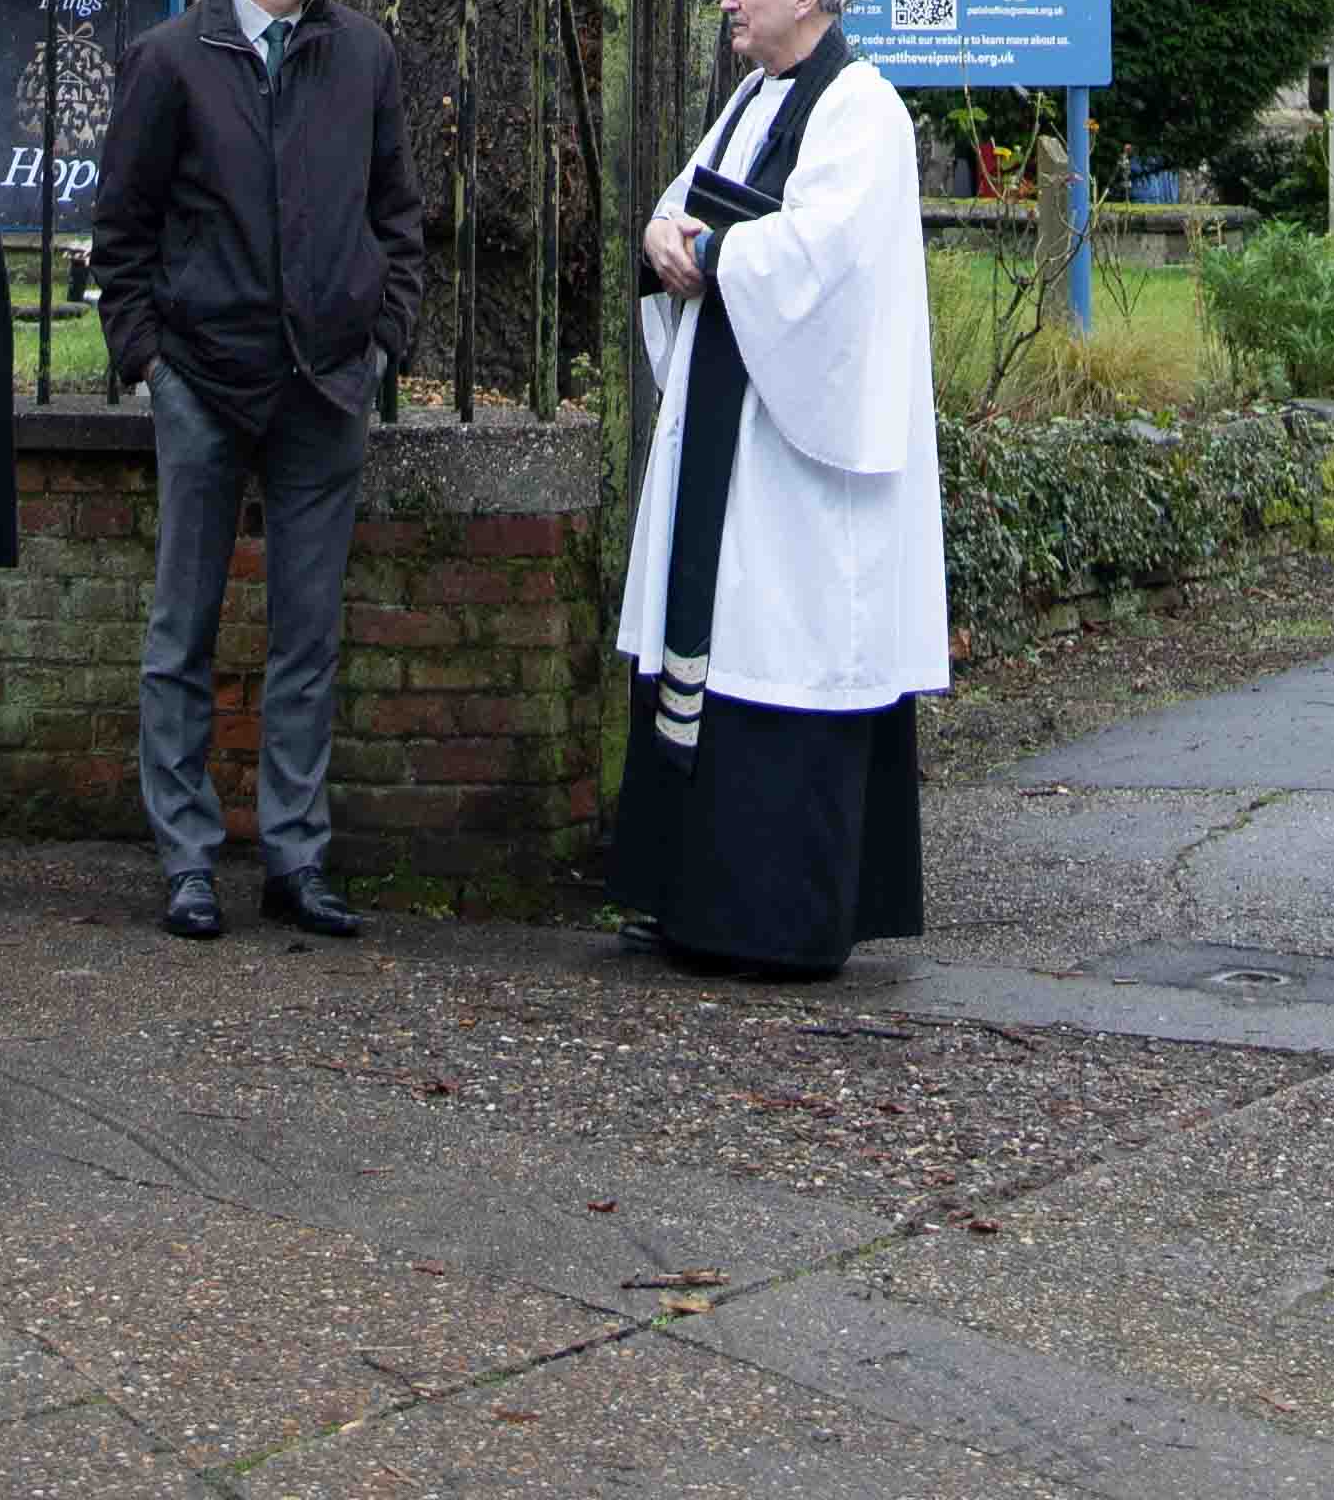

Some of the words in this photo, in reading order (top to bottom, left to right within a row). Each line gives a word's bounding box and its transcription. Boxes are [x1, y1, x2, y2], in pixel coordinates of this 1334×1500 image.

[862, 35, 884, 45] code
[936, 35, 969, 46] websie
[0, 147, 100, 203] Hop
